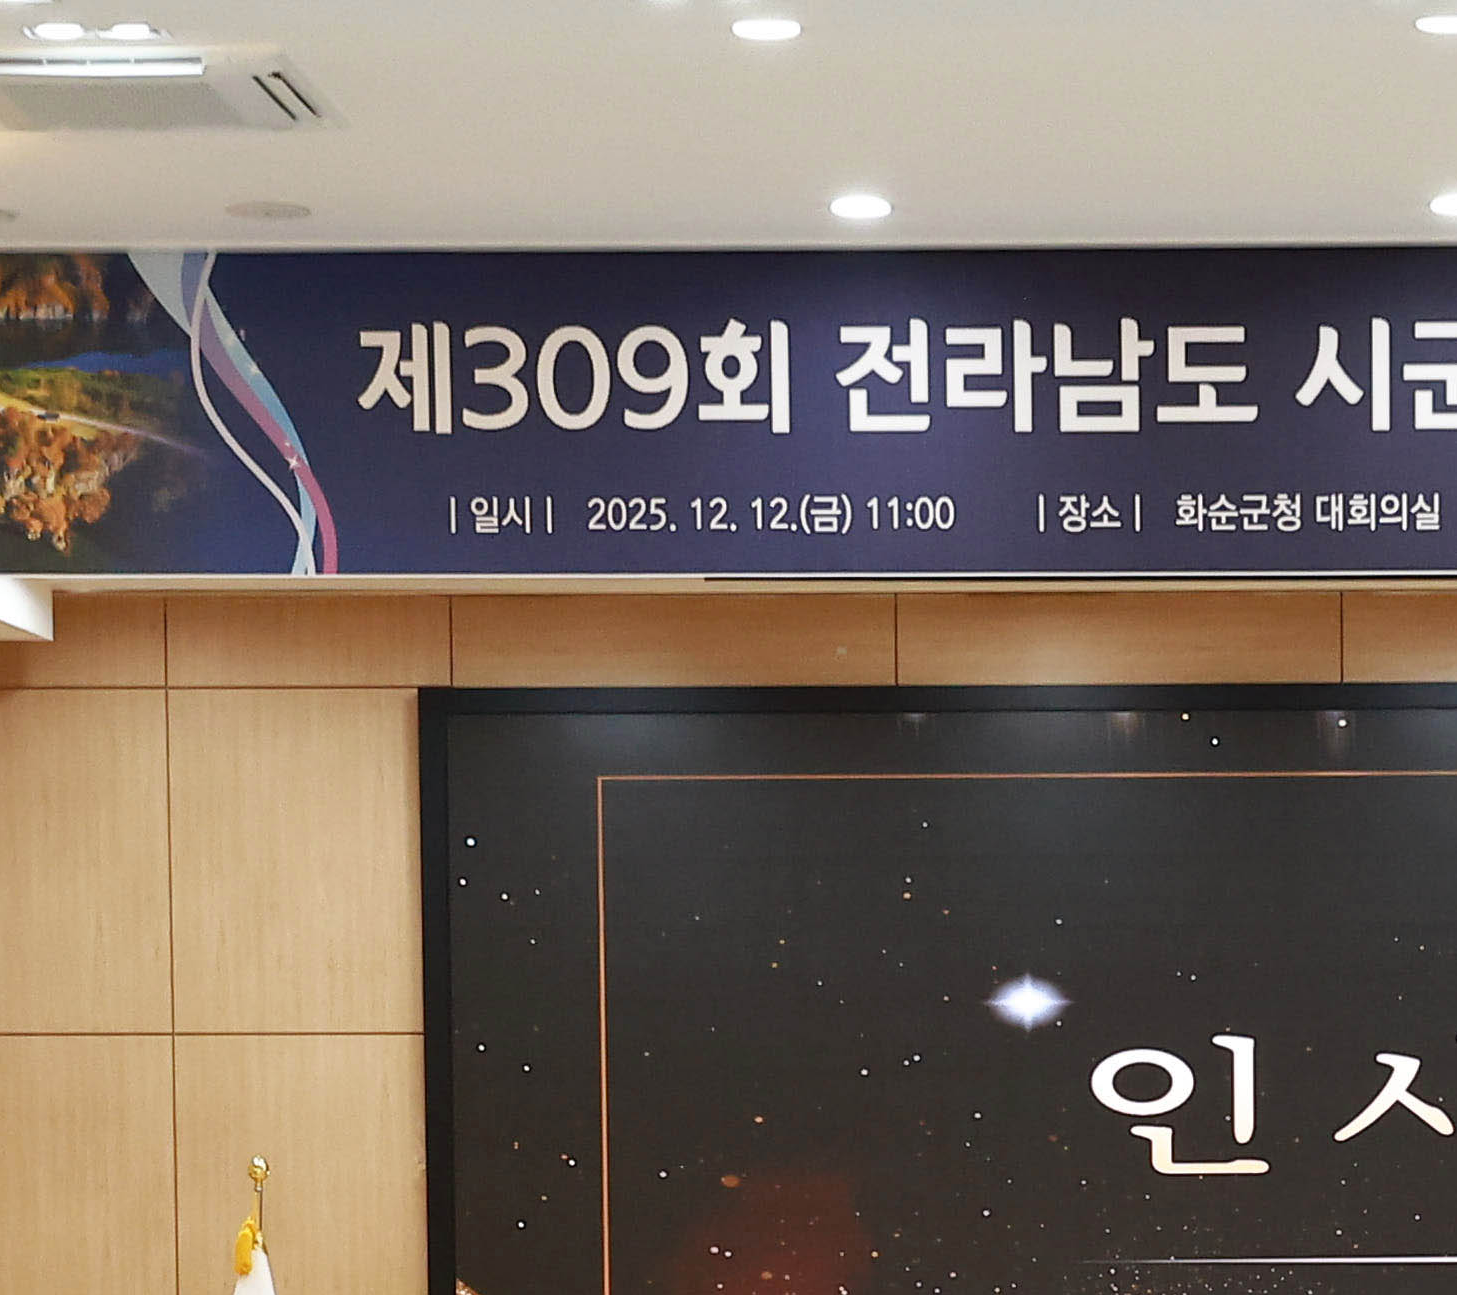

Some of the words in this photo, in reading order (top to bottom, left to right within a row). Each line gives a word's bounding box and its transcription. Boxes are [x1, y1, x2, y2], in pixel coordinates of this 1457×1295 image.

[357, 318, 791, 435] 제309회
[835, 317, 1259, 433] 전라남도
[470, 497, 531, 534] 일시
[588, 498, 676, 532] 2025.
[690, 498, 737, 532] 12.
[751, 495, 852, 534] 12.(금)
[866, 496, 954, 531] 11:00
[1058, 495, 1122, 532] 장소
[1175, 493, 1302, 532] 화순군청
[1315, 493, 1441, 532] 대회의실
